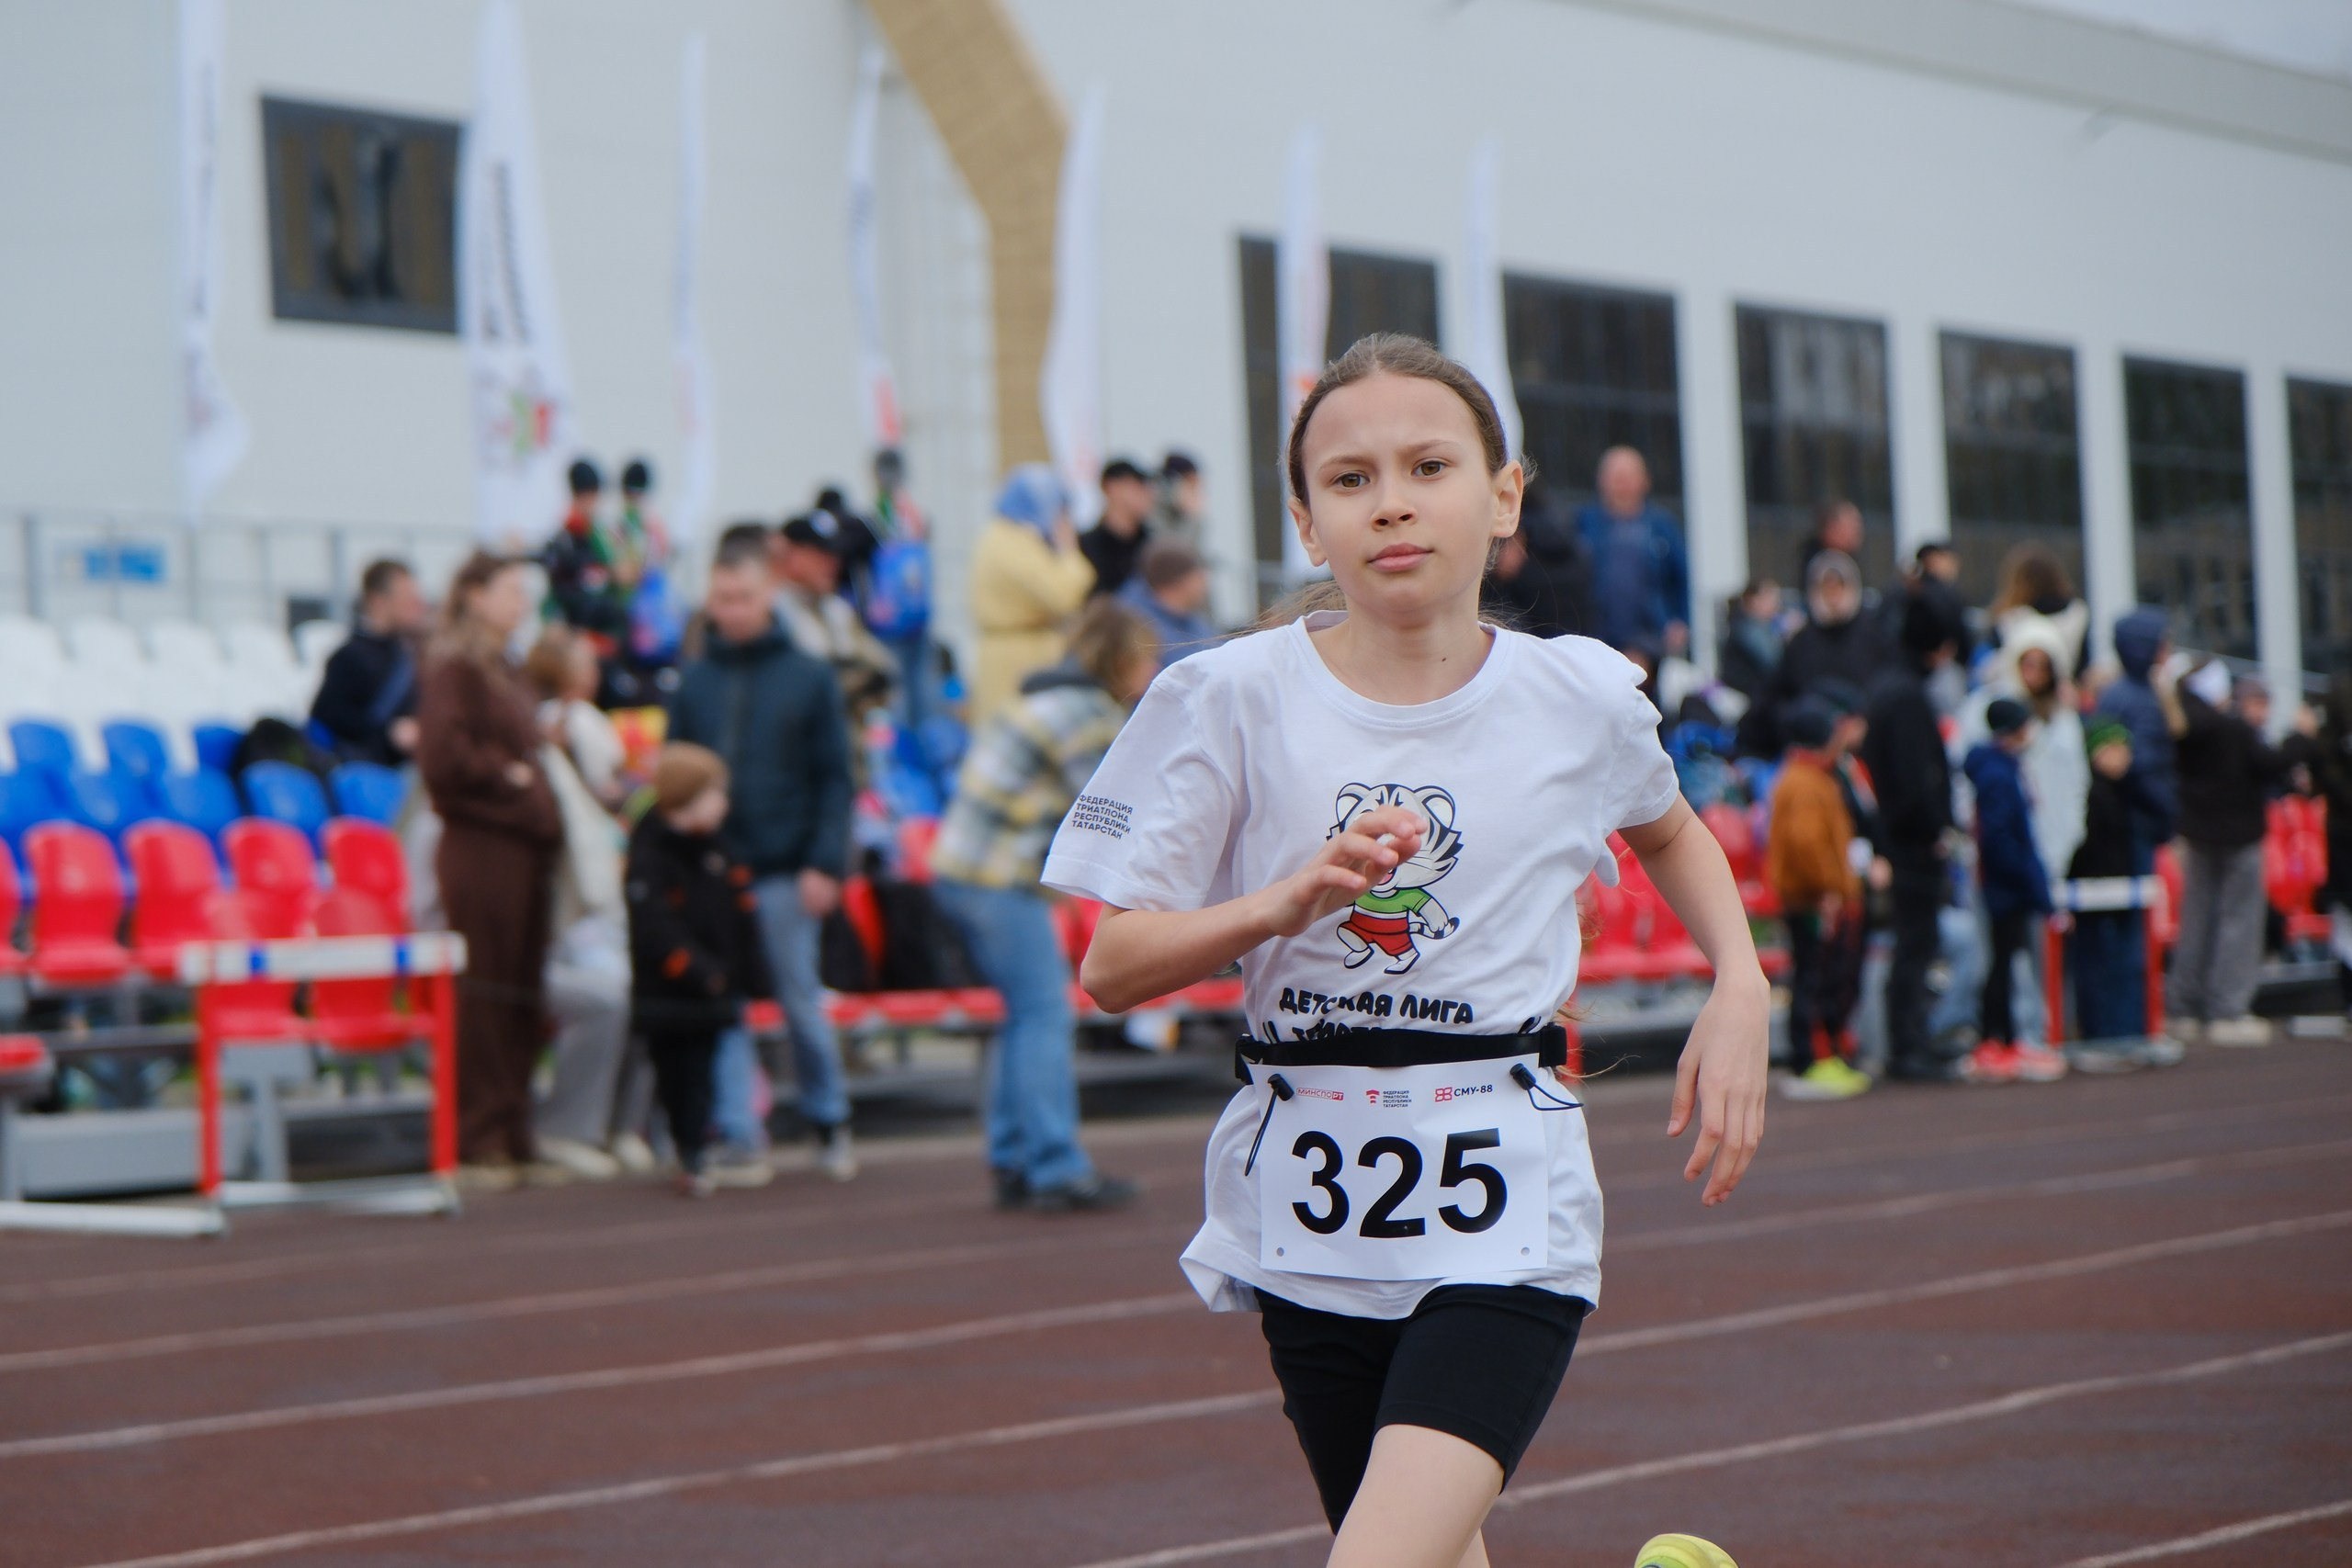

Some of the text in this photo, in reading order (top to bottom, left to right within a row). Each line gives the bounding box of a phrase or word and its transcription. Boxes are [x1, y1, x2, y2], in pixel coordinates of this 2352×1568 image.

[1076, 803, 1128, 823] ТРИАТЛОНА
[1080, 795, 1133, 815] ФЕДЕРАЦИЯ
[1072, 820, 1123, 840] ТАТАРСТАН
[1073, 812, 1131, 834] РЕСПУБЛИКИ
[1279, 987, 1474, 1024] ДЕТСКАЯ ЛИГА
[1297, 1089, 1343, 1100] МИНСПОРТ
[1453, 1084, 1493, 1097] СМУ-88
[1292, 1128, 1508, 1238] 325
